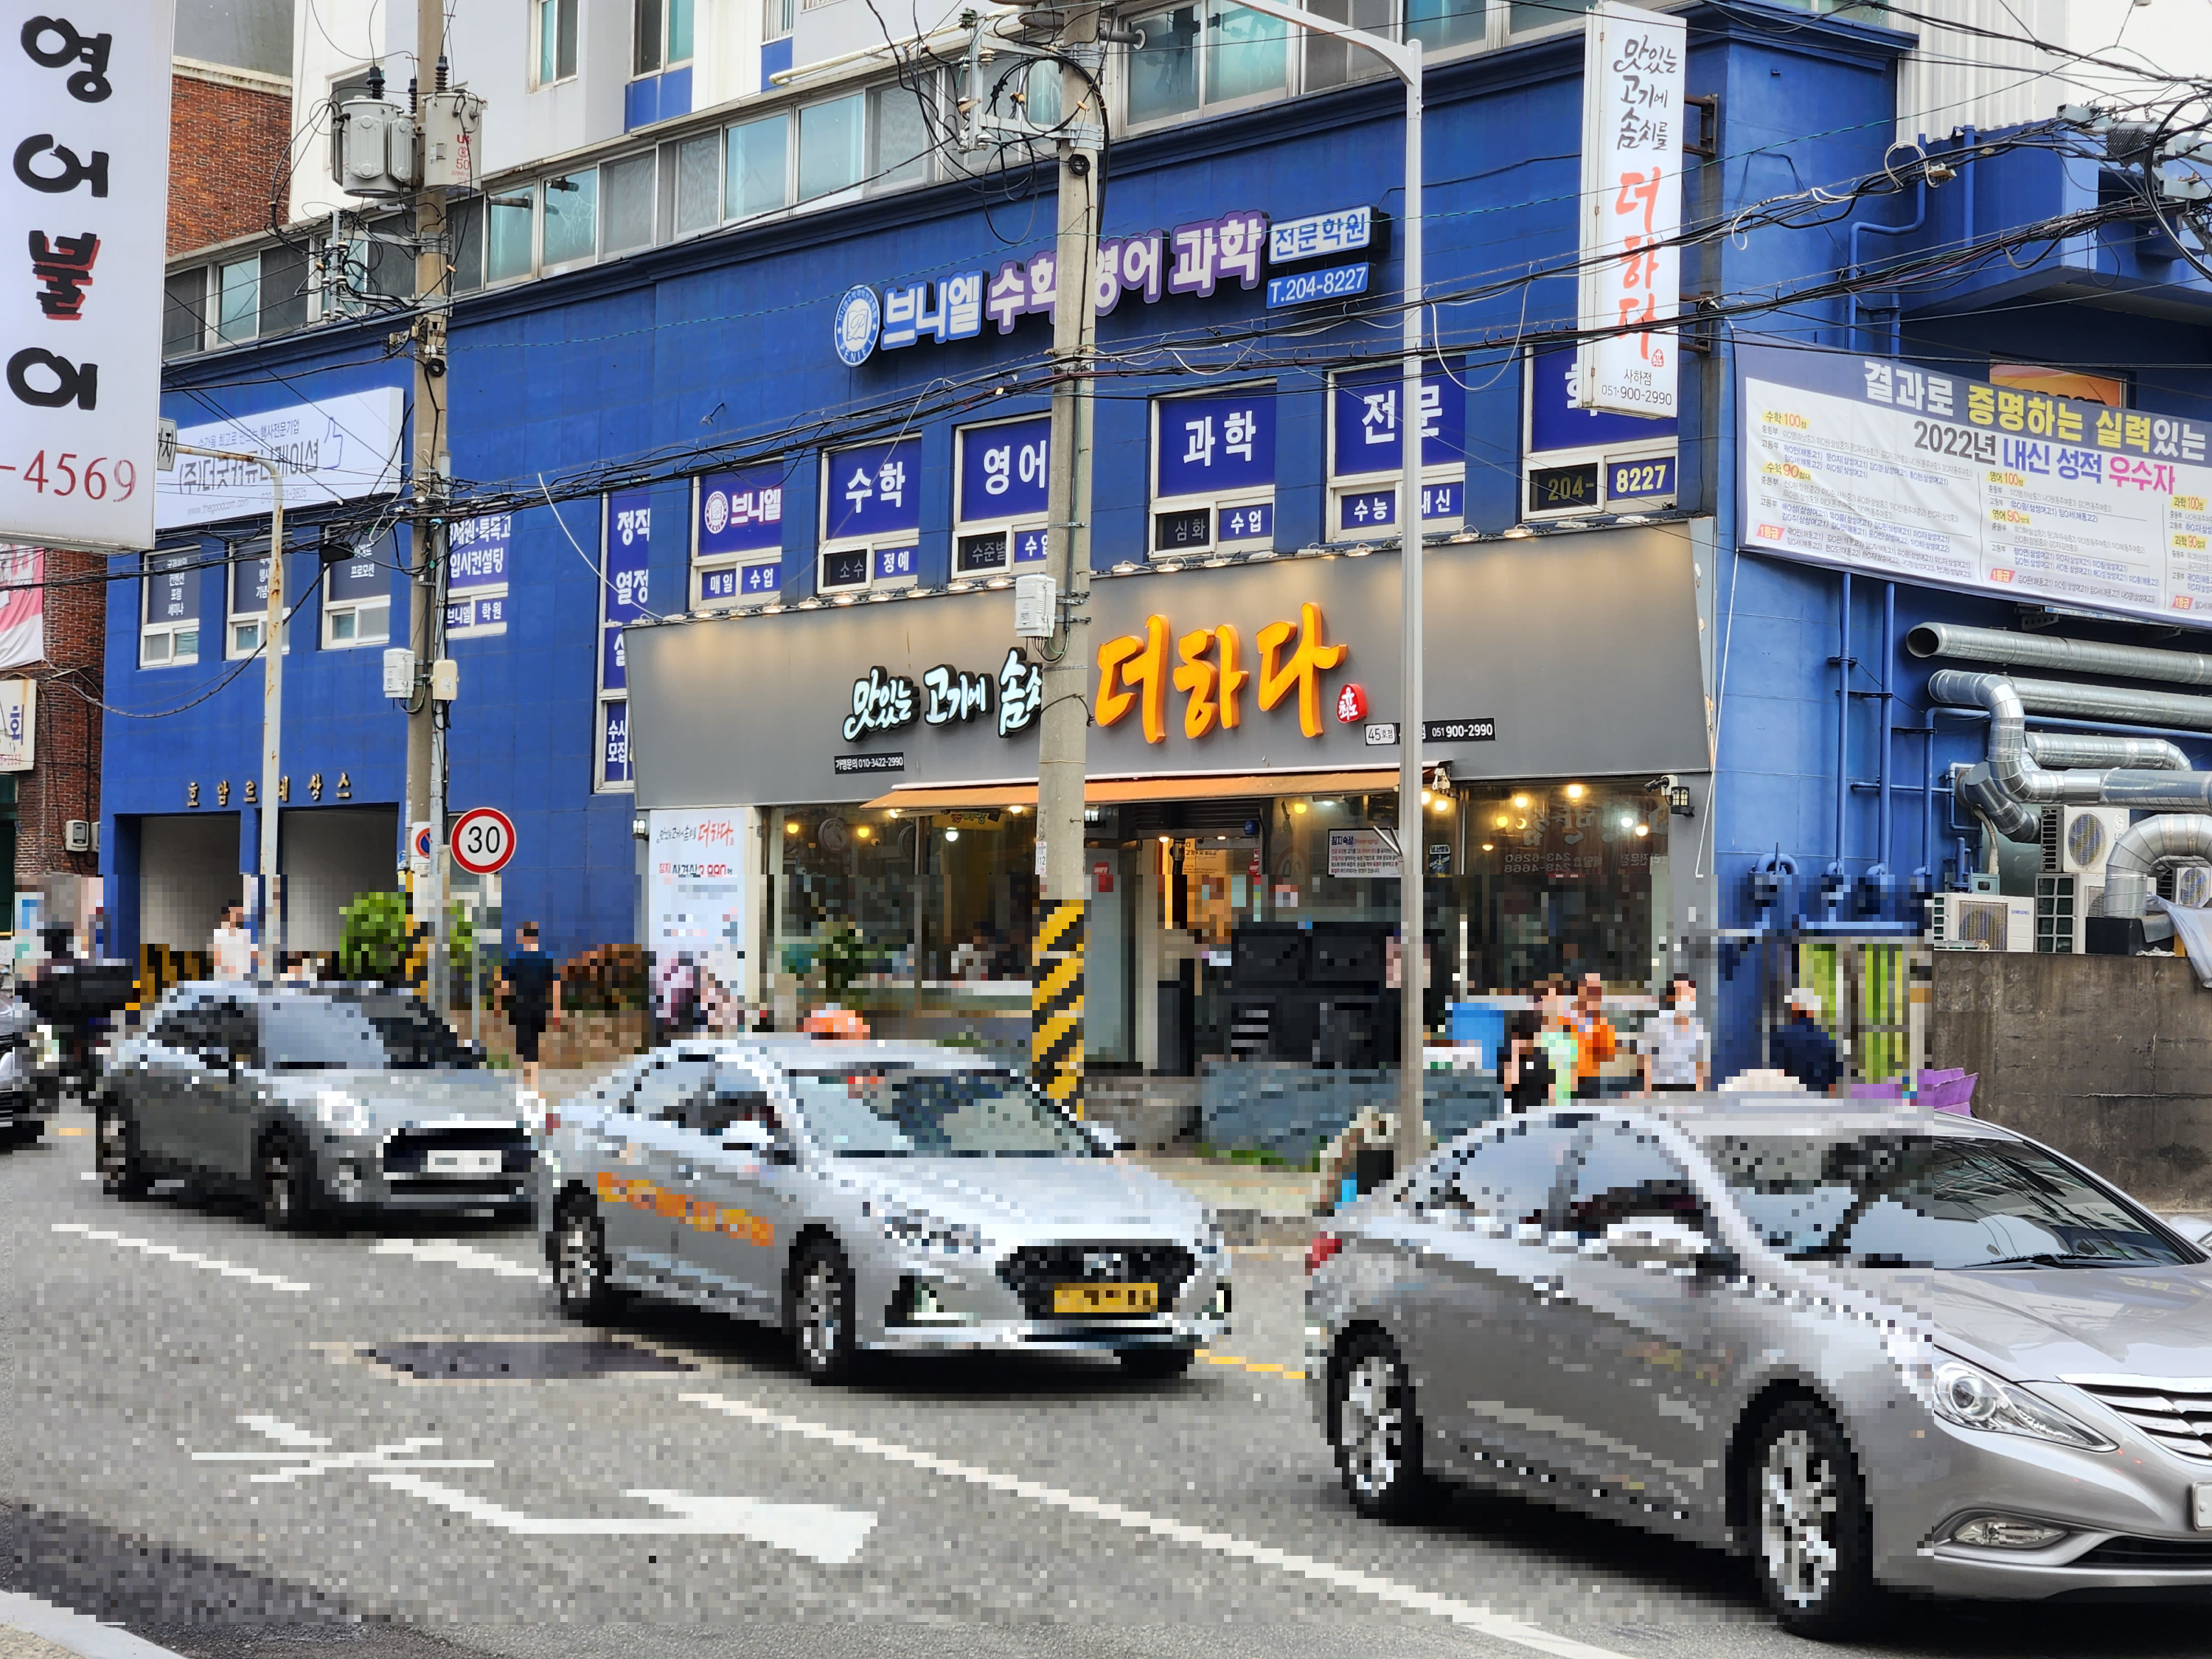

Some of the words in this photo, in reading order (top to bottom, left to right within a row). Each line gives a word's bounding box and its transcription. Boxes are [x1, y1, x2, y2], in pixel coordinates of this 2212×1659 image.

[1613, 35, 1677, 74] 맛있는
[1620, 74, 1668, 108] 고기에
[1275, 212, 1366, 258] 전문학원
[883, 275, 981, 344] 브니엘
[1095, 234, 1159, 308] 영어
[1173, 217, 1262, 290] 과학
[1270, 266, 1367, 305] T.204-8227
[839, 338, 874, 363] PENIEL
[1624, 369, 1652, 386] 사하점
[1864, 361, 1954, 417] 결과로
[1968, 384, 2083, 442] 증명하는
[2096, 409, 2205, 462] 실력있는
[1183, 410, 1256, 467] 과학
[984, 439, 1048, 495] 영어
[1913, 420, 1997, 466] 2022년
[2003, 437, 2050, 476] 내신
[2057, 447, 2102, 484] 성적
[2109, 456, 2176, 495] 우수자
[845, 461, 906, 514] 수학
[1615, 464, 1667, 493] 8227
[731, 488, 782, 524] 브니엘
[1353, 497, 1388, 522] 수능
[1175, 518, 1206, 542] 심화
[1230, 509, 1262, 535] 수업
[450, 547, 504, 578] 입시컨설팅
[839, 557, 865, 580] 소수
[883, 550, 909, 574] 정예
[709, 567, 734, 594] 매일
[749, 567, 774, 591] 수업
[481, 601, 502, 622] 학원
[1095, 602, 1348, 744] 더하다
[843, 667, 914, 741] 맛있는
[924, 666, 988, 725] 고기에
[1445, 723, 1493, 738] 900-2990
[858, 754, 904, 769] 010-3422-2990
[467, 826, 501, 854] 30
[698, 819, 734, 848] 더하다
